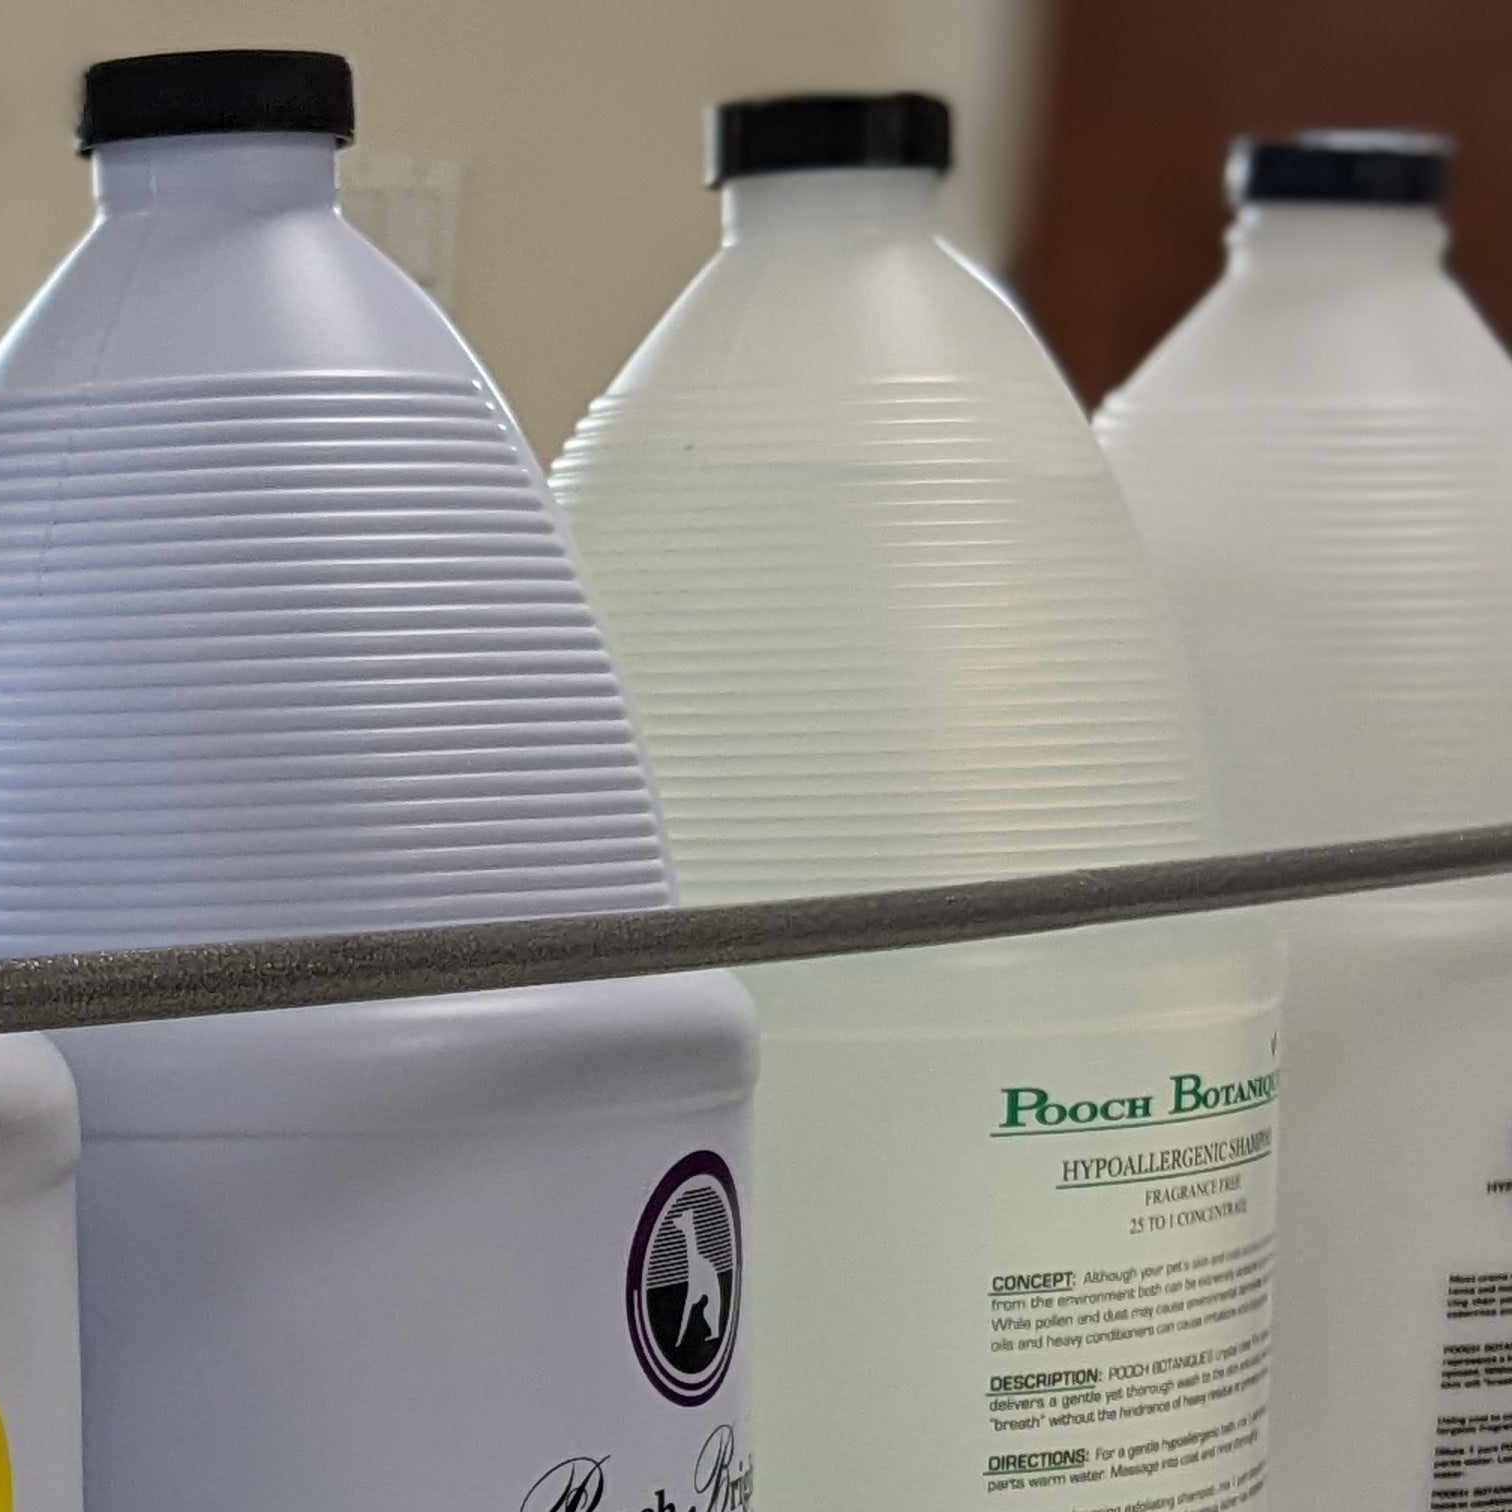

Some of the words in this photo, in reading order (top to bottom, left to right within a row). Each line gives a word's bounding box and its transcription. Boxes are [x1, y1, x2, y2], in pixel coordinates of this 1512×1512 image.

[999, 1087, 1153, 1128] POOCH
[1062, 1142, 1228, 1182] HYPOALLERGENIC
[1145, 1181, 1217, 1206] FRAGRANCE
[1129, 1217, 1145, 1235] 25
[1148, 1214, 1166, 1232] TO
[992, 1271, 1077, 1292] CONCEPT:
[991, 1298, 1026, 1312] from
[1030, 1296, 1054, 1309] the
[1077, 1309, 1100, 1325] and
[1017, 1335, 1043, 1351] and
[1045, 1334, 1083, 1350] heavy
[990, 1367, 1103, 1392] DESCRIPTION:
[1049, 1395, 1057, 1408] a
[1105, 1387, 1123, 1405] yet
[1048, 1410, 1096, 1427] without
[1097, 1407, 1117, 1421] the
[988, 1447, 1090, 1473] DIRECTIONS:
[1096, 1446, 1116, 1461] For
[1118, 1447, 1126, 1459] a
[1028, 1473, 1067, 1488] warm
[1110, 1461, 1159, 1480] Massage
